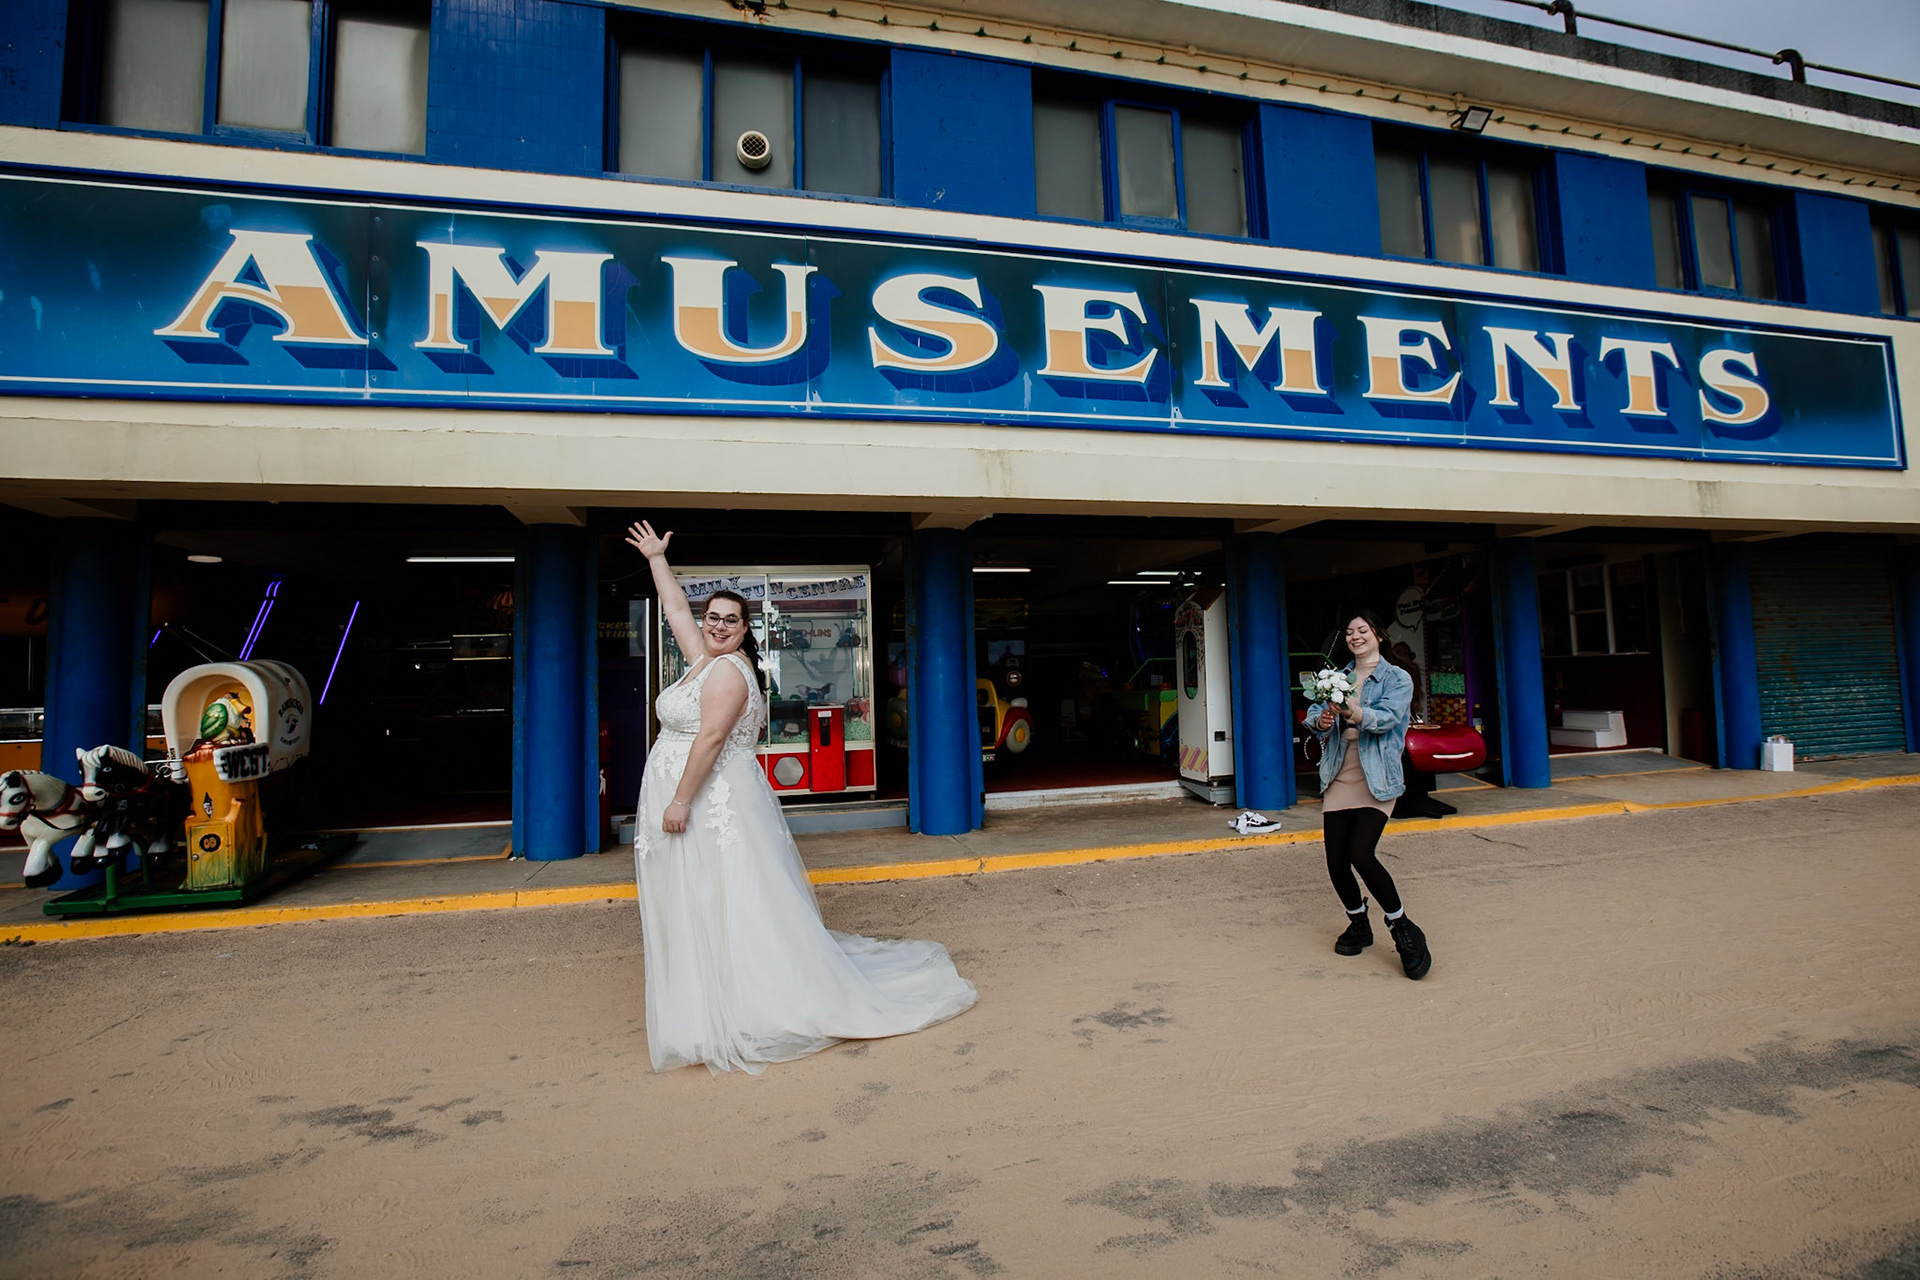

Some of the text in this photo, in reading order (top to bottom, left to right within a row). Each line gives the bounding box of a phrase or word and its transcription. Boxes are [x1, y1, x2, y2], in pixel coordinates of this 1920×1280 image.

[153, 227, 1771, 426] AMUSEMENTS
[681, 575, 866, 600] AMILY FUN CENTRE
[226, 745, 269, 778] WEST
